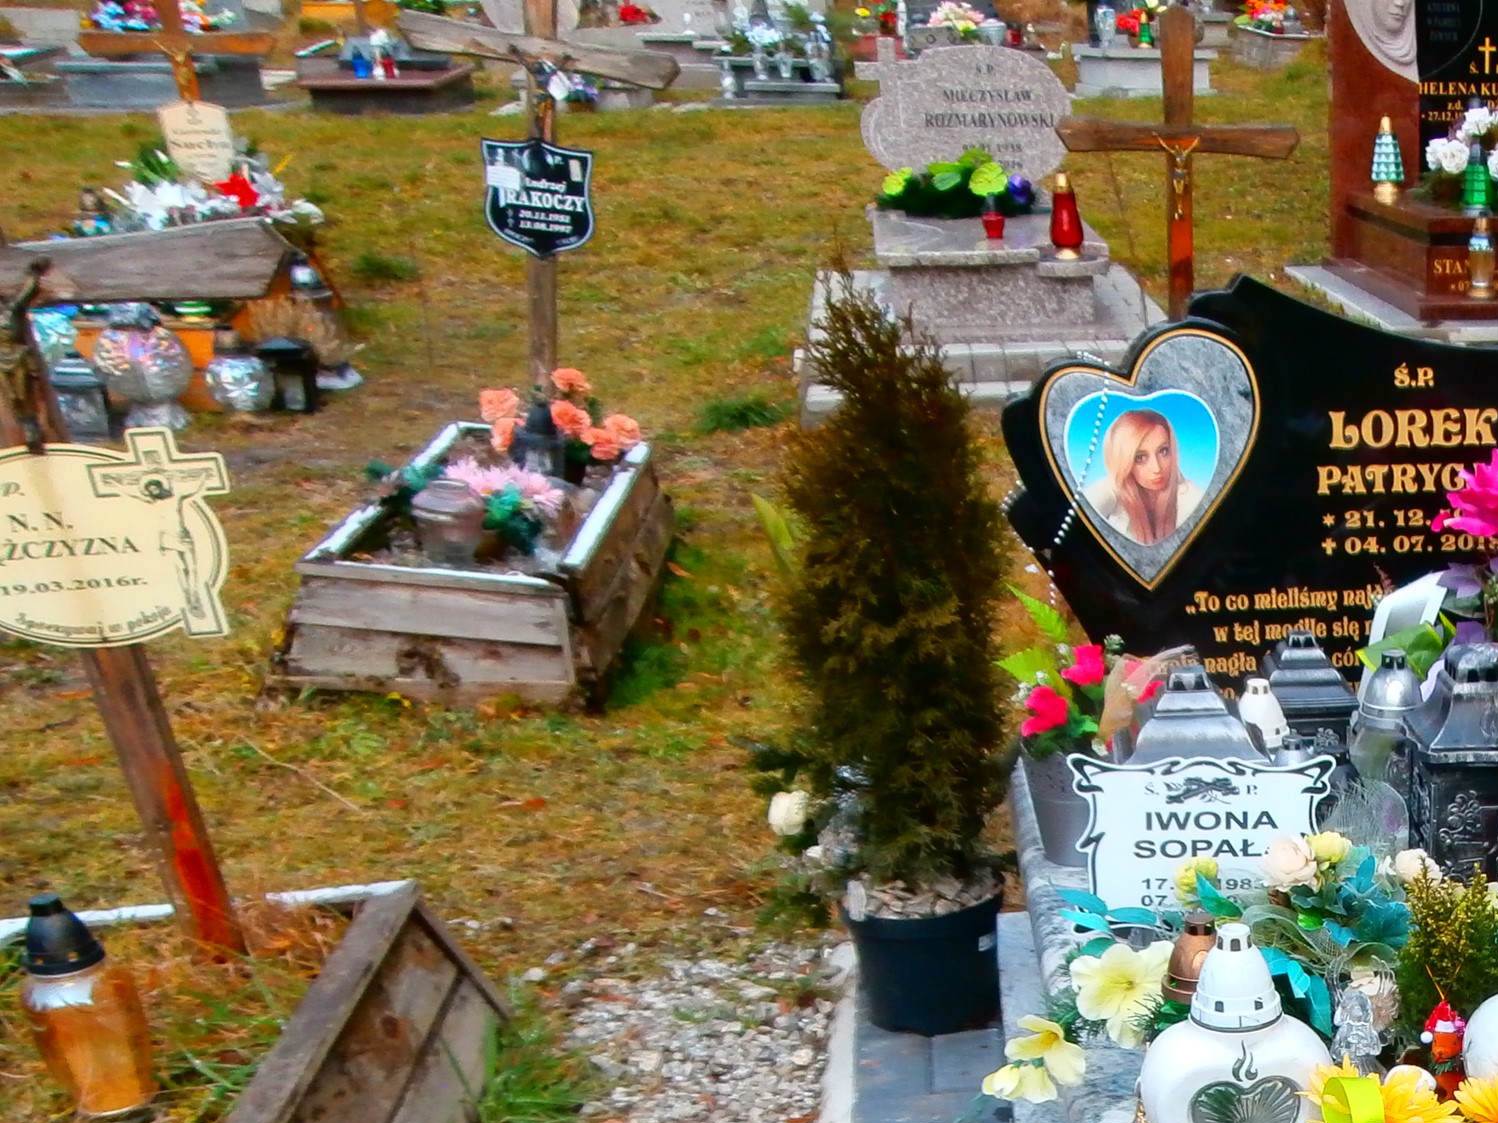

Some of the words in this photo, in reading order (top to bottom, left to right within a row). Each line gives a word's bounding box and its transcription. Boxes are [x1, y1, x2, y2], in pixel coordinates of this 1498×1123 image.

[1419, 81, 1477, 95] HELENA
[924, 112, 1055, 129] ROZMARYNOWSKI
[505, 188, 586, 213] RAKOCZY
[1328, 407, 1498, 450] LOREK
[1316, 463, 1480, 496] PATRYC
[1344, 508, 1385, 529] 21.
[1393, 507, 1431, 528] 12.
[1344, 535, 1386, 555] 04.
[1392, 534, 1433, 553] 07.
[1225, 593, 1249, 611] co
[1253, 585, 1338, 612] mieliśmy
[1213, 625, 1228, 643] w
[1234, 619, 1260, 646] tej
[1332, 615, 1360, 642] się
[1204, 651, 1257, 678] nagła
[1145, 811, 1278, 831] IWONA
[1133, 837, 1272, 859] SOPAŁ
